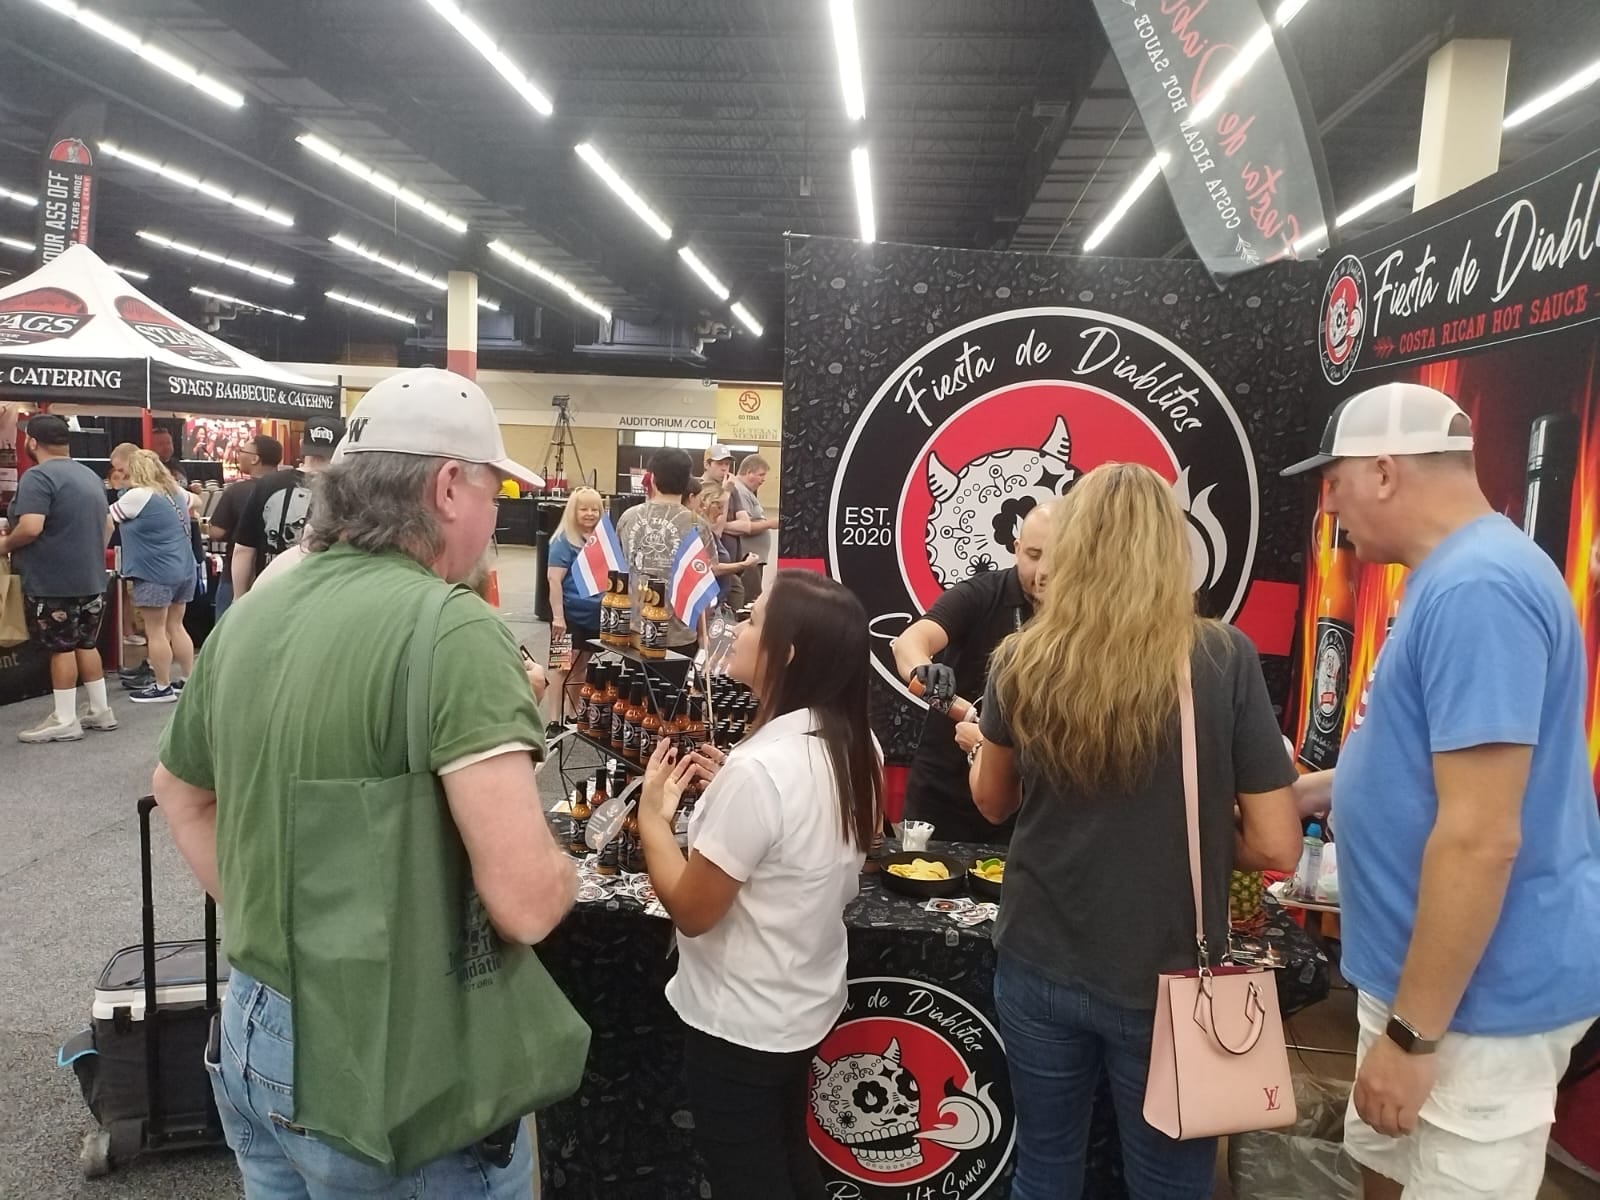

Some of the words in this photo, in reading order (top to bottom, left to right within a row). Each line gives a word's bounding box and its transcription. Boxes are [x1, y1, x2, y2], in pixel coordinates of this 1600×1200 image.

[47, 170, 70, 199] OFF
[73, 174, 83, 199] MADE
[45, 201, 67, 230] ASS
[71, 200, 81, 230] TEXAS
[1373, 244, 1439, 337] Fiesta
[1447, 240, 1481, 304] de
[1490, 166, 1600, 303] Diabl
[1400, 330, 1436, 354] COSTA
[1441, 315, 1486, 346] RICAN
[1492, 304, 1523, 335] HOT
[1529, 284, 1589, 327] SAUCE
[10, 366, 121, 389] CATERING
[895, 342, 995, 428] Fiesta
[1015, 328, 1052, 367] de
[1071, 326, 1202, 434] Diablitos
[168, 376, 213, 397] STAGS
[215, 382, 277, 404] BARBECUE
[278, 390, 287, 404] &
[288, 391, 334, 409] CATERING
[619, 416, 683, 428] AUDITORIUM
[844, 507, 890, 526] EST.
[842, 528, 891, 546] 2020
[867, 988, 890, 1010] de
[903, 989, 984, 1053] Diablitos
[942, 1157, 987, 1200] Sauce
